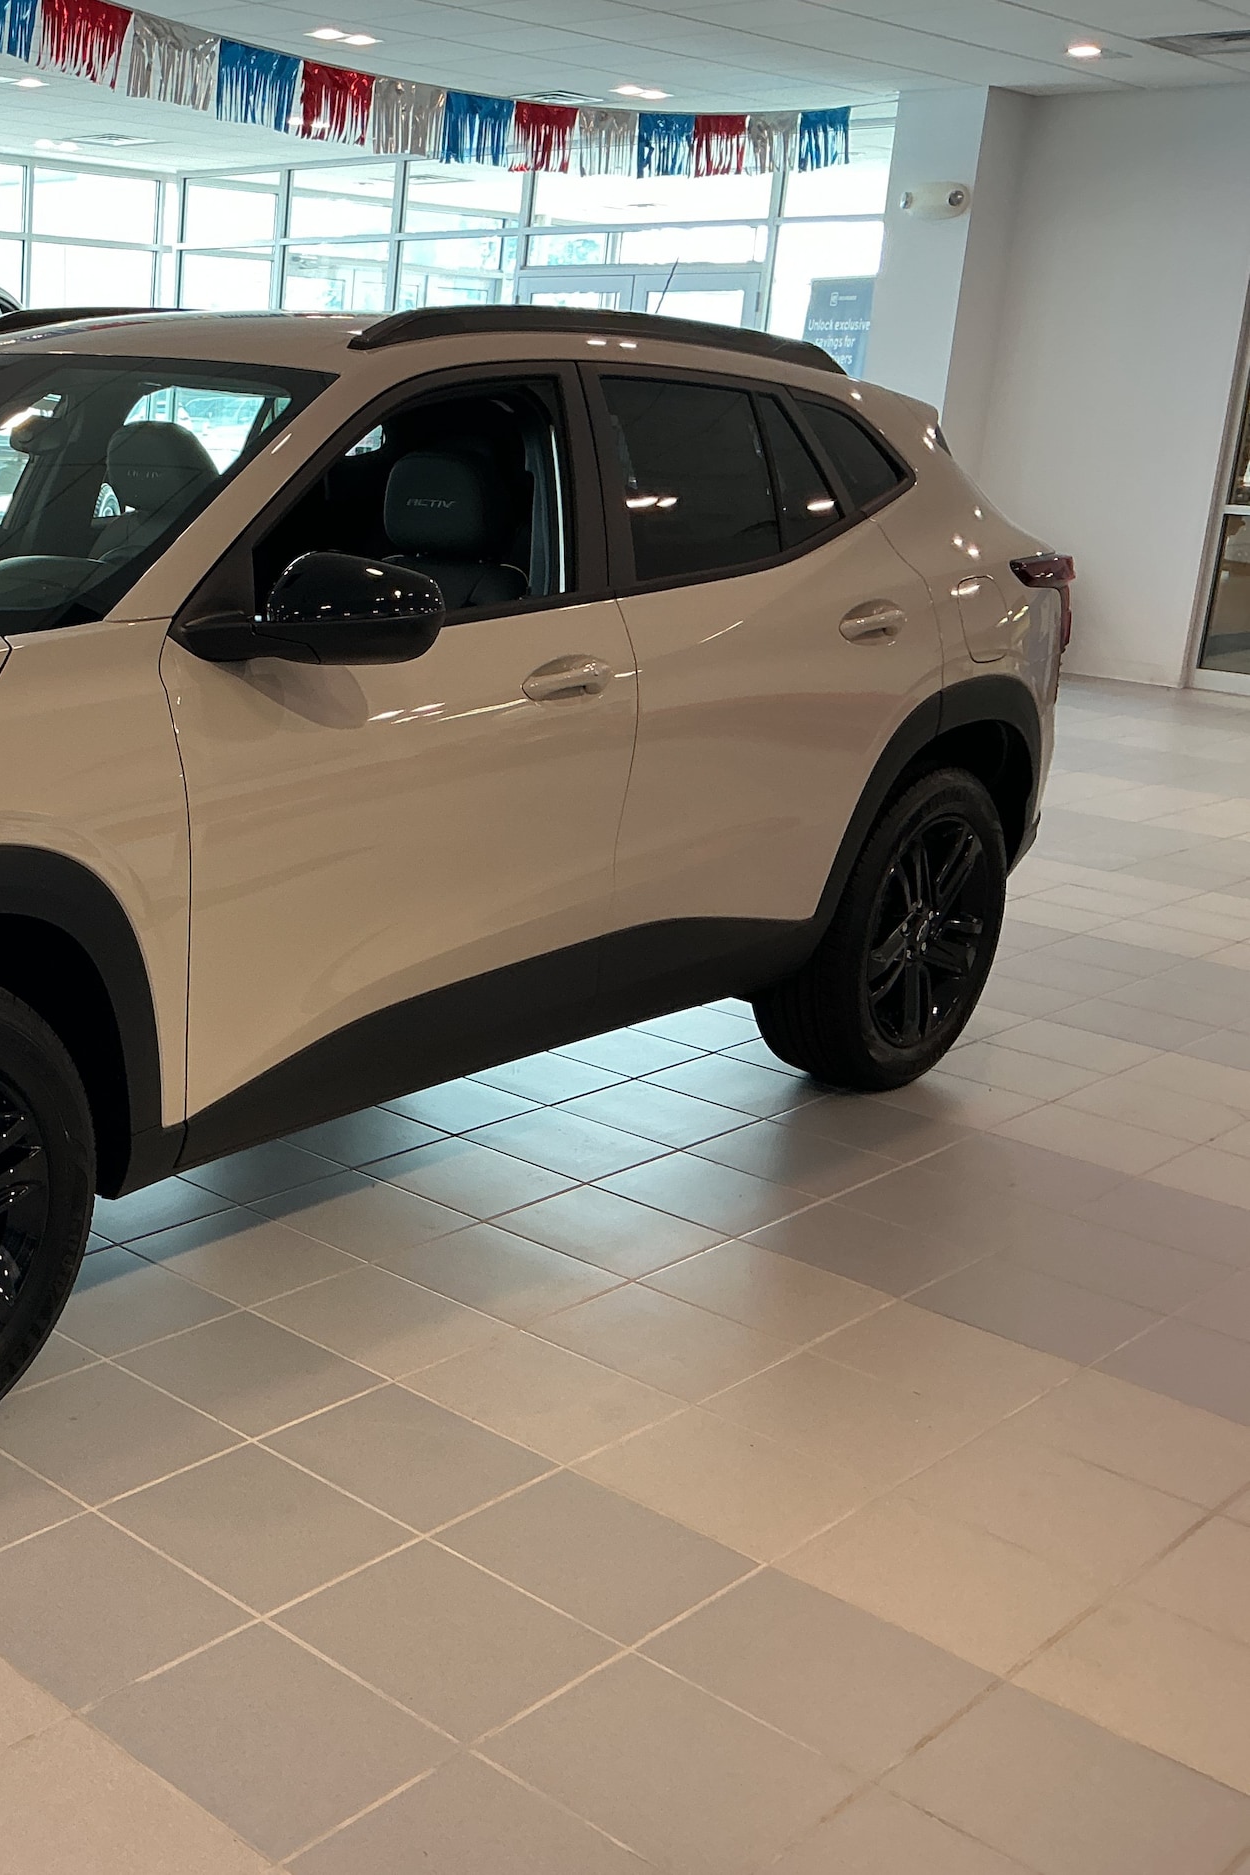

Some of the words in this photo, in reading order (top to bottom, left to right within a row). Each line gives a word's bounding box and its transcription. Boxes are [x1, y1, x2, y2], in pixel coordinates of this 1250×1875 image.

[808, 318, 833, 331] Unlock
[834, 318, 871, 331] exclusive
[815, 335, 842, 350] savings
[843, 335, 856, 347] for
[406, 498, 456, 508] ACTIV
